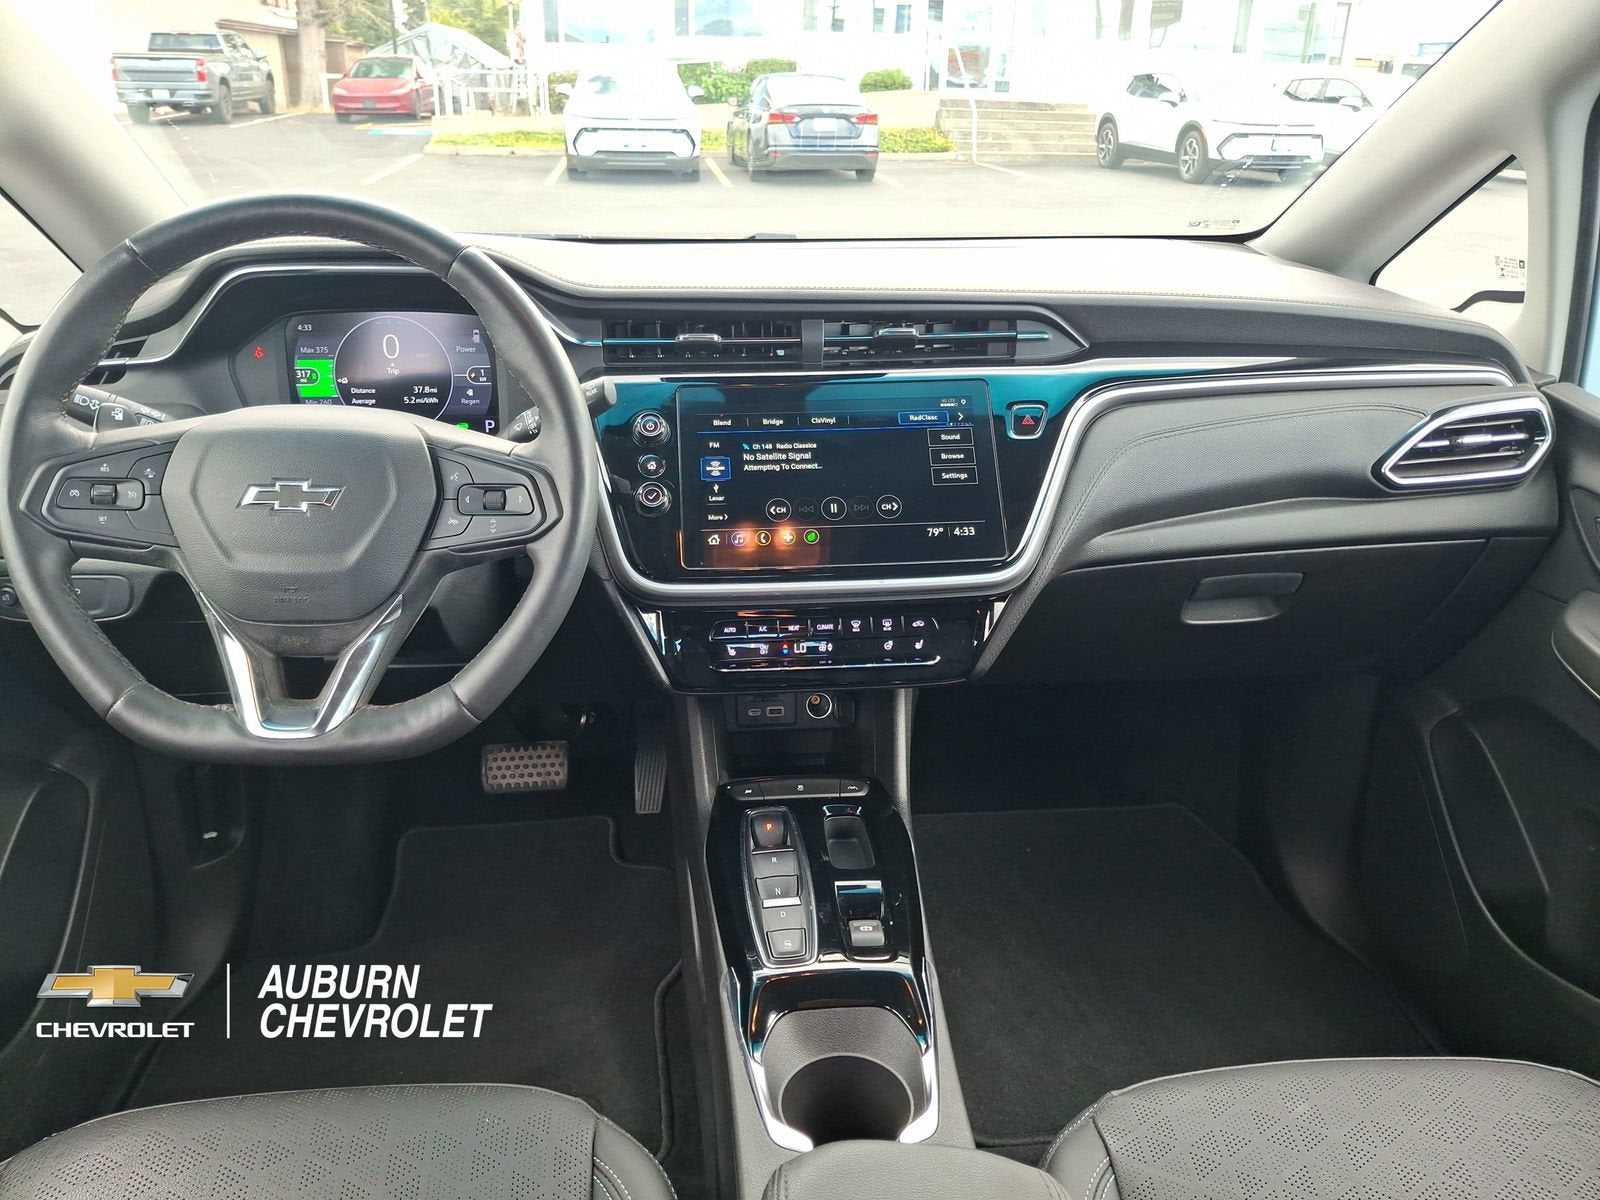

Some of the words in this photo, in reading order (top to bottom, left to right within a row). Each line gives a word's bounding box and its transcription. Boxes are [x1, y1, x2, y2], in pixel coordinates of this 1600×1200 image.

[382, 334, 399, 359] 0
[456, 345, 477, 353] Power
[295, 370, 311, 378] 317
[387, 367, 400, 375] Trip
[461, 398, 481, 406] Regen
[485, 419, 496, 433] P
[762, 418, 784, 426] Bridge
[743, 453, 755, 461] No
[755, 452, 786, 460] Satellite
[788, 452, 812, 461] Signal
[743, 463, 781, 472] Attempting
[941, 472, 968, 480] Settings
[953, 526, 976, 536] 4:33
[794, 643, 807, 653] LO
